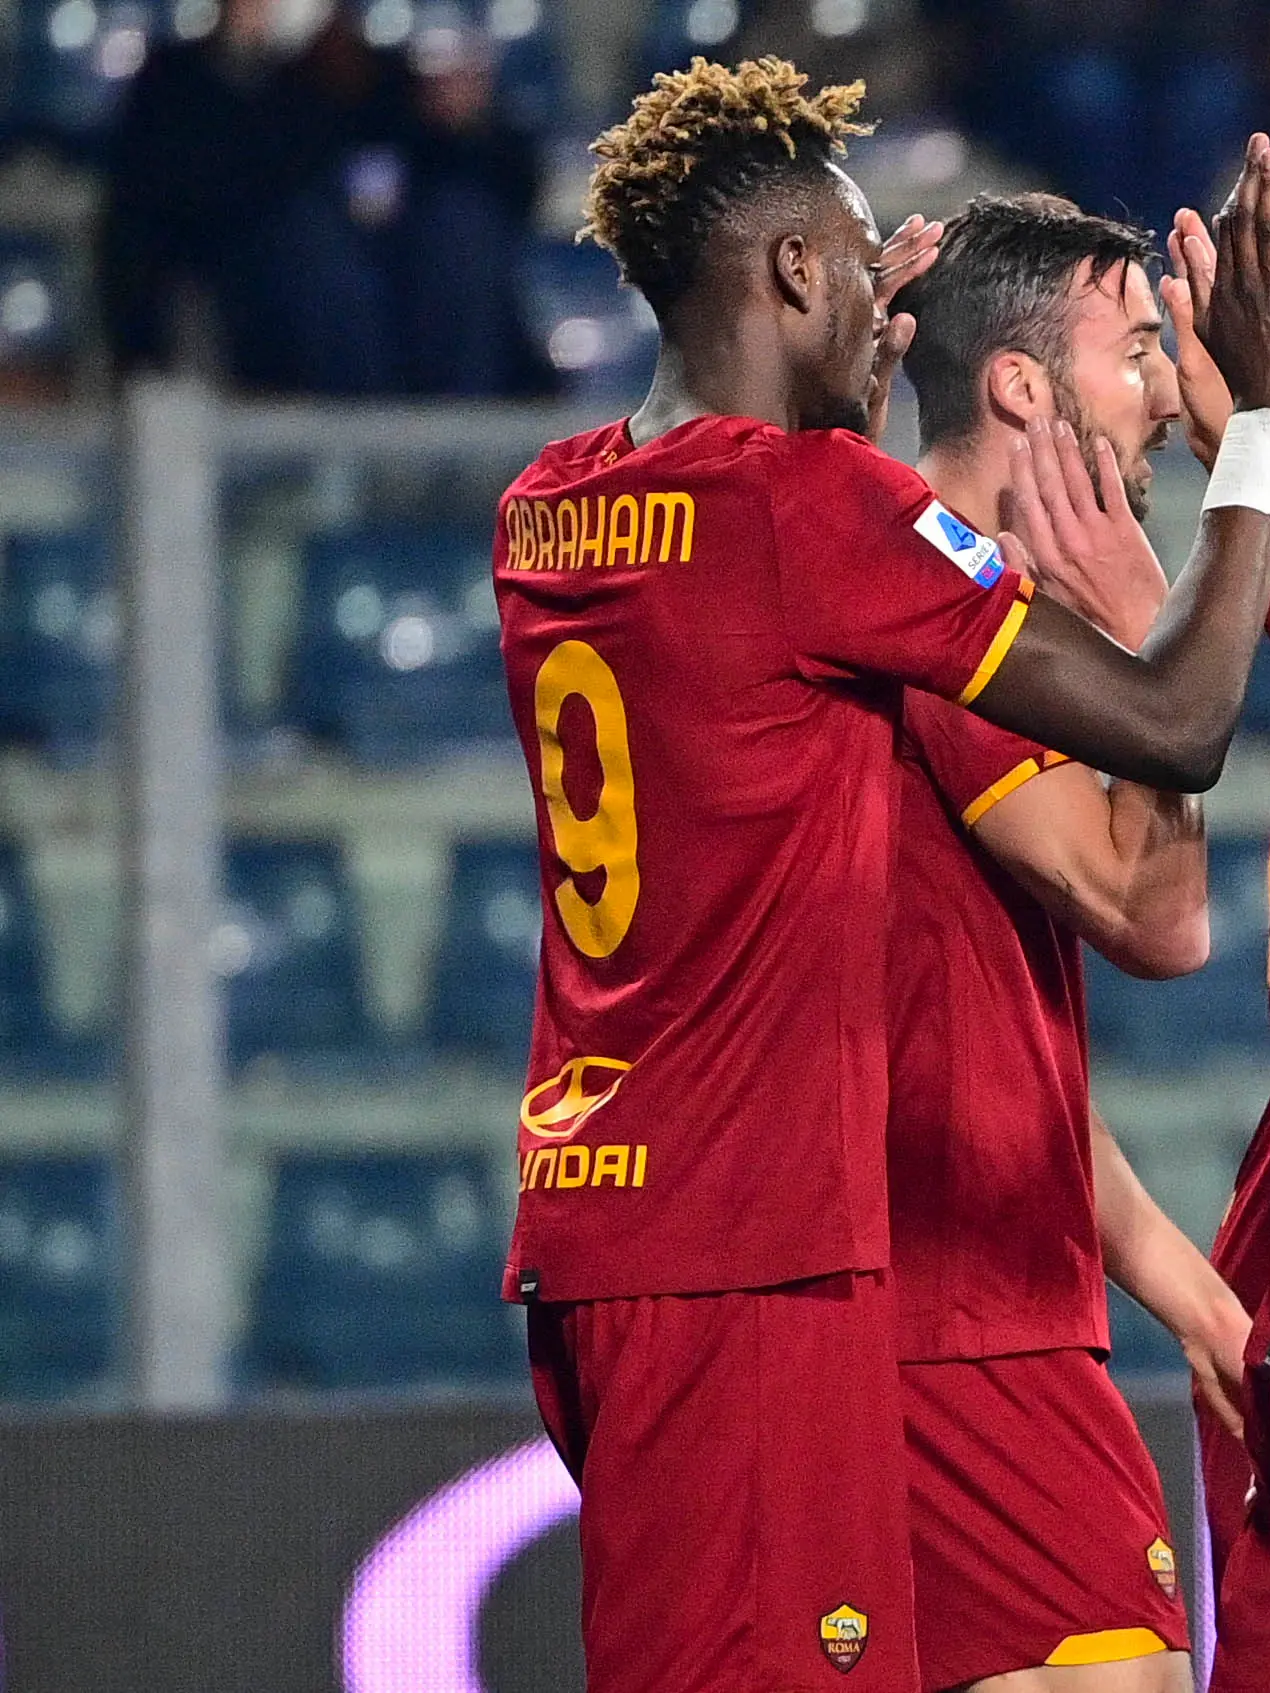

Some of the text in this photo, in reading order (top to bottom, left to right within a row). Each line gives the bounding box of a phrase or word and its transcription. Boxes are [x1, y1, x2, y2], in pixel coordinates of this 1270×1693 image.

[506, 492, 695, 570] ABRAHAM
[535, 640, 640, 958] 9
[827, 1642, 860, 1654] ROMA
